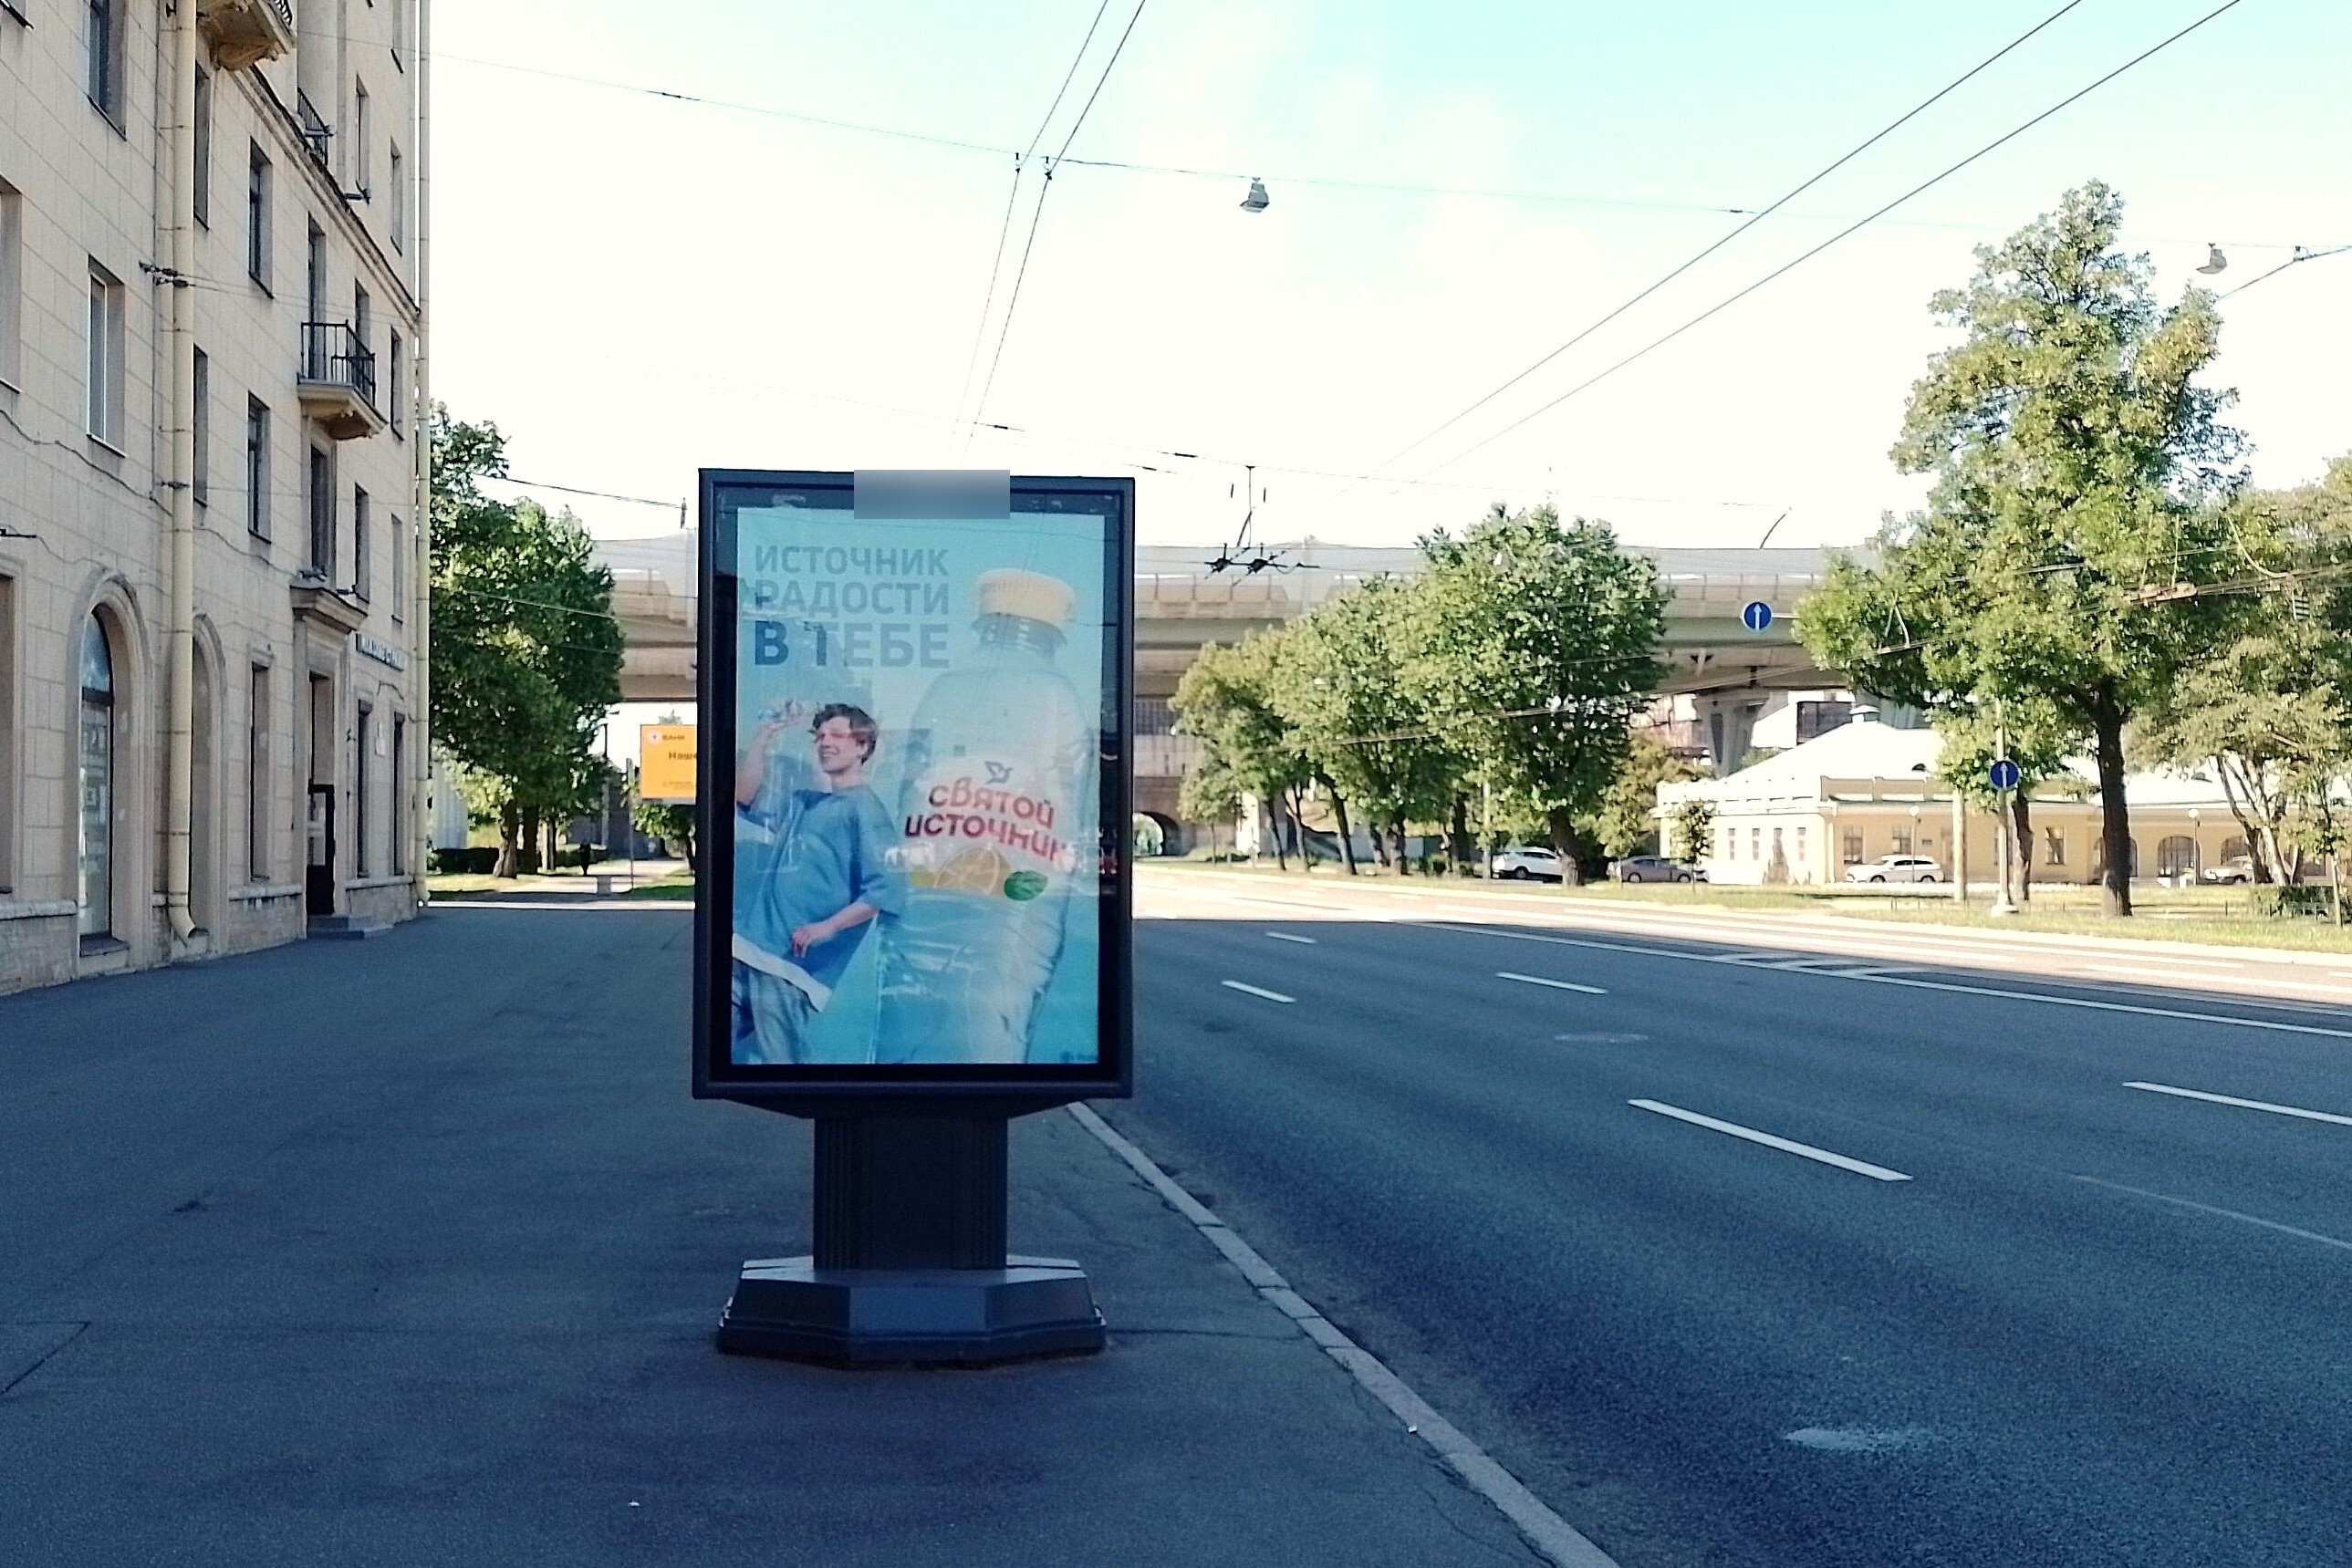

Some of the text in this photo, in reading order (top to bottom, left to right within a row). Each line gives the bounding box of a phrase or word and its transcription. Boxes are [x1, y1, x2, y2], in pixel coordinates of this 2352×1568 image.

[755, 545, 949, 576] ИСТОЧНИК
[755, 579, 949, 618] РАДОСТИ
[755, 620, 950, 668] В ТЕБЕ
